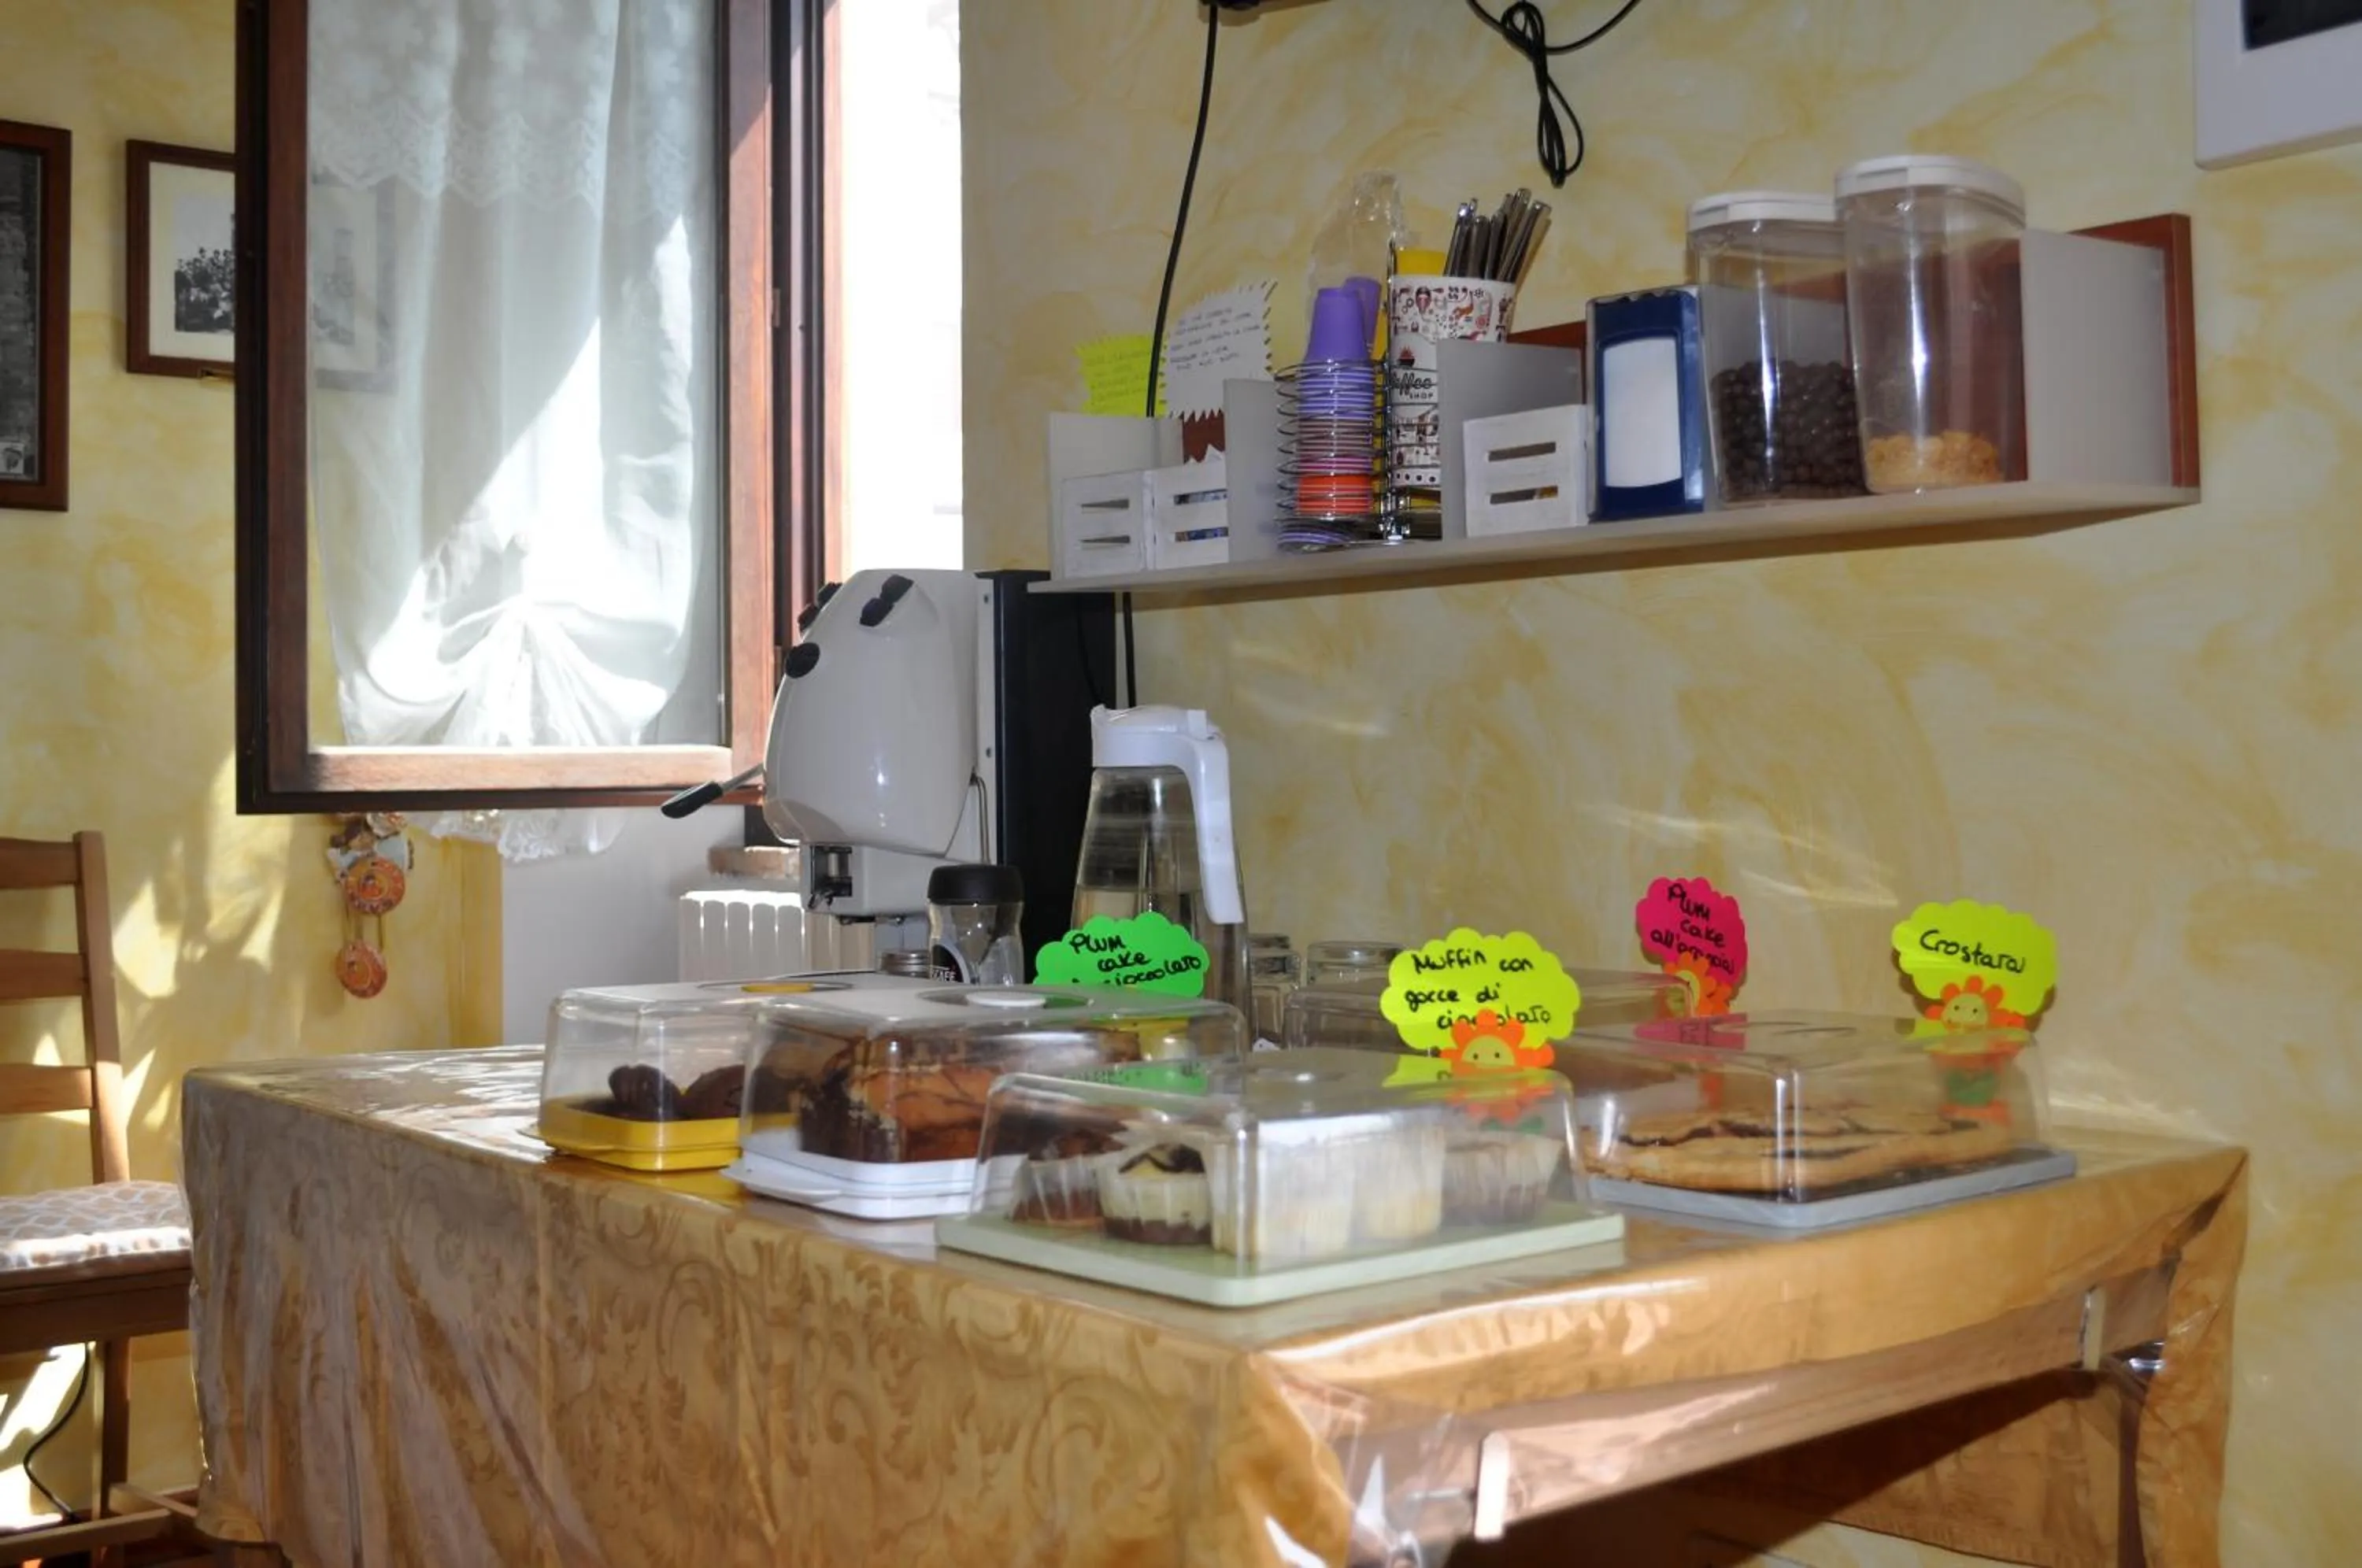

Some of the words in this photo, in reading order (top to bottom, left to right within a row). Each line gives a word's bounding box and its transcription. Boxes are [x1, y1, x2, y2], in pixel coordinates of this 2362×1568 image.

[1412, 949, 1486, 974] Muffin
[1499, 958, 1534, 972] con
[1920, 929, 2026, 974] Crostata
[1405, 989, 1460, 1012] gocce
[1475, 982, 1501, 1004] di
